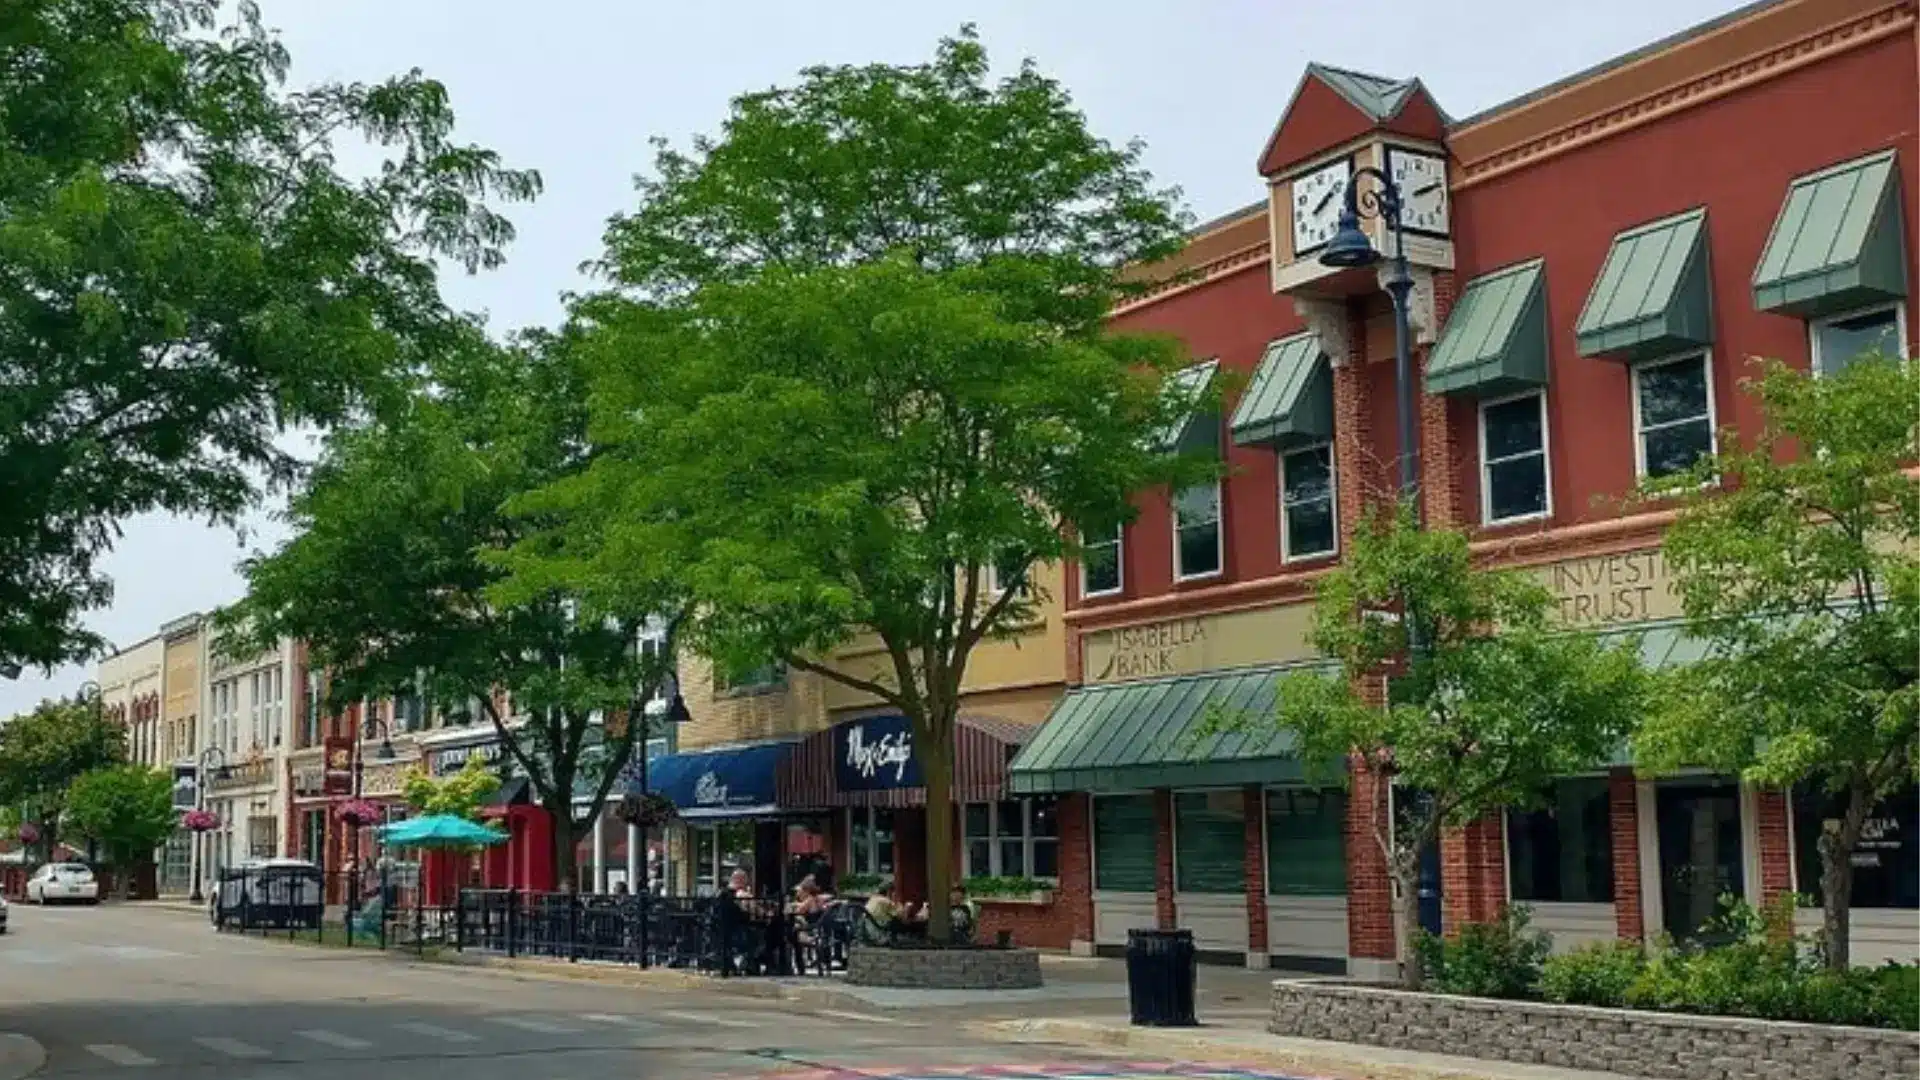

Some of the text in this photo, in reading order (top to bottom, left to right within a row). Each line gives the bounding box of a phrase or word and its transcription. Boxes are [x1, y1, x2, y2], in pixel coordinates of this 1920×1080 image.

[1560, 586, 1653, 624] TRUST
[1117, 619, 1208, 651] ISABELLA
[1117, 648, 1175, 677] BANK
